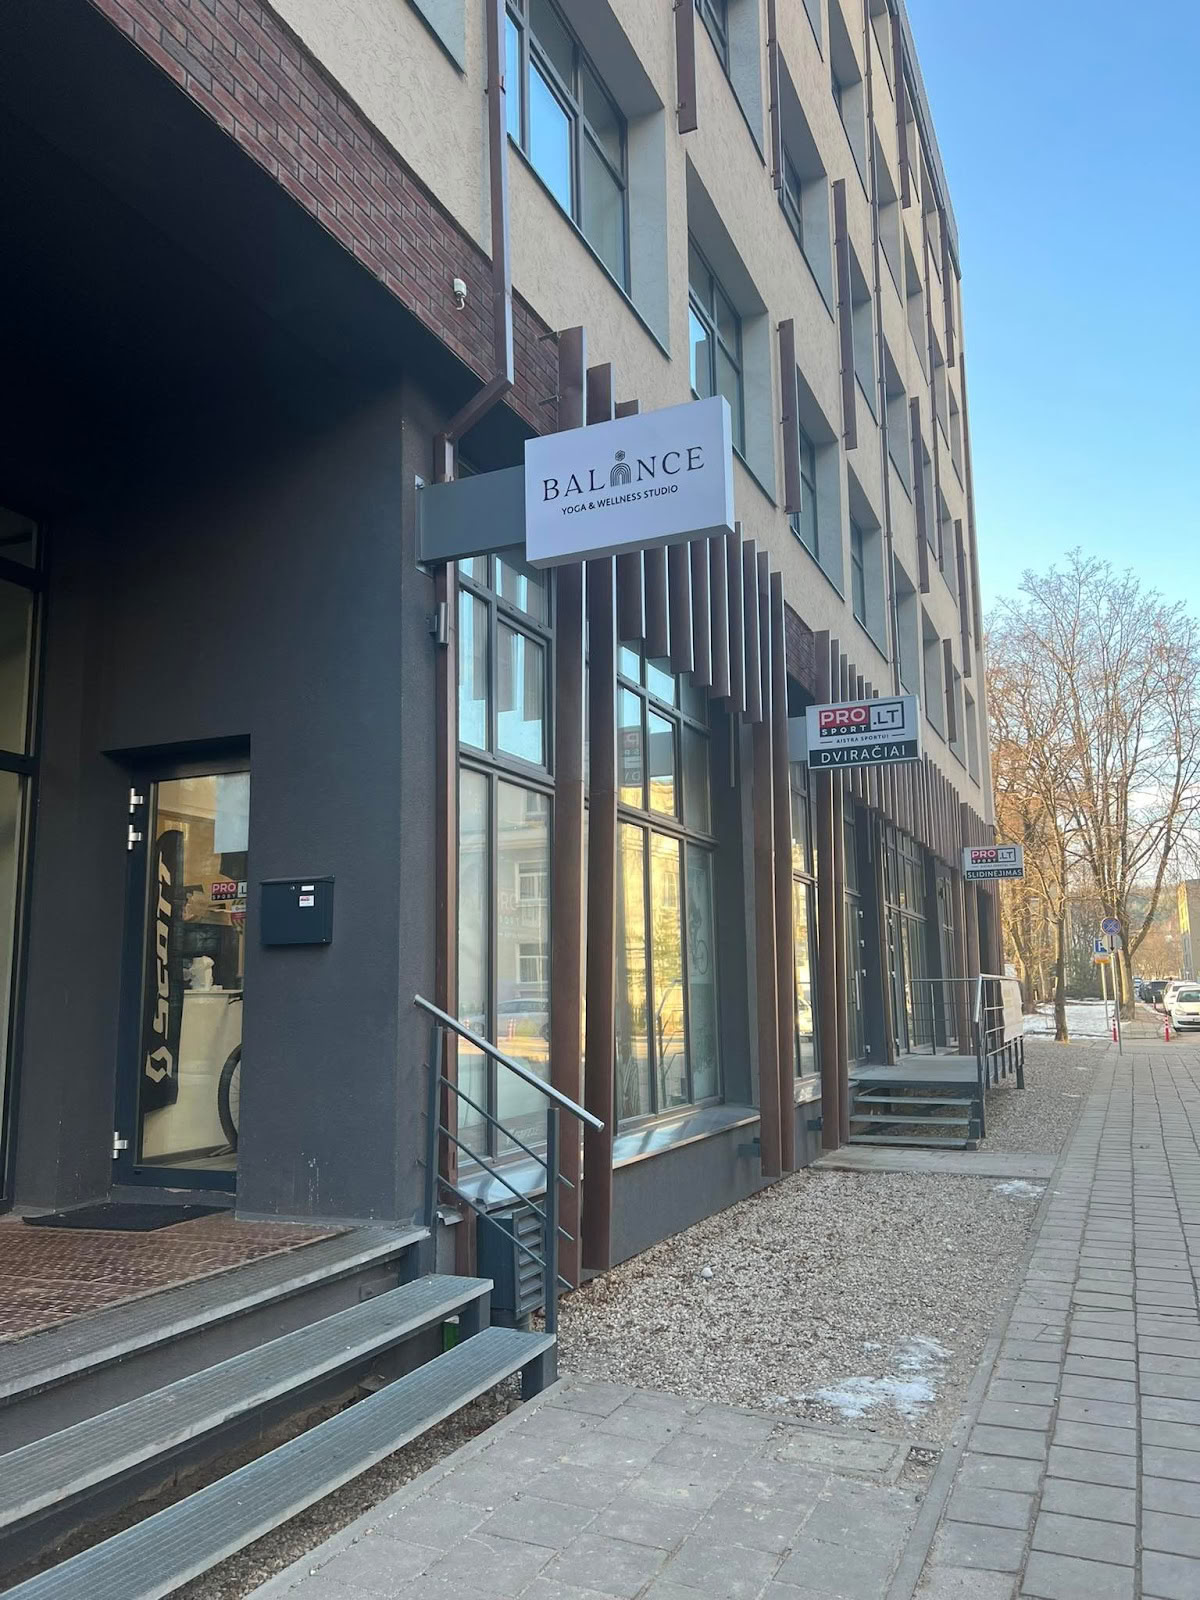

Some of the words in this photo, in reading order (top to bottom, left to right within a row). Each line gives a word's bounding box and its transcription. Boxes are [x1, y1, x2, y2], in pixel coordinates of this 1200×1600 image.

[561, 504, 587, 515] YOGA
[588, 501, 596, 510] &
[597, 491, 642, 508] WELLNESS
[643, 484, 679, 499] STUDIO
[820, 708, 866, 726] PRO
[821, 725, 867, 736] SPORT
[821, 745, 905, 764] DVIRAČIAI
[972, 850, 996, 858] PRO
[212, 883, 236, 893] PRO
[153, 851, 172, 1040] SCOTT
